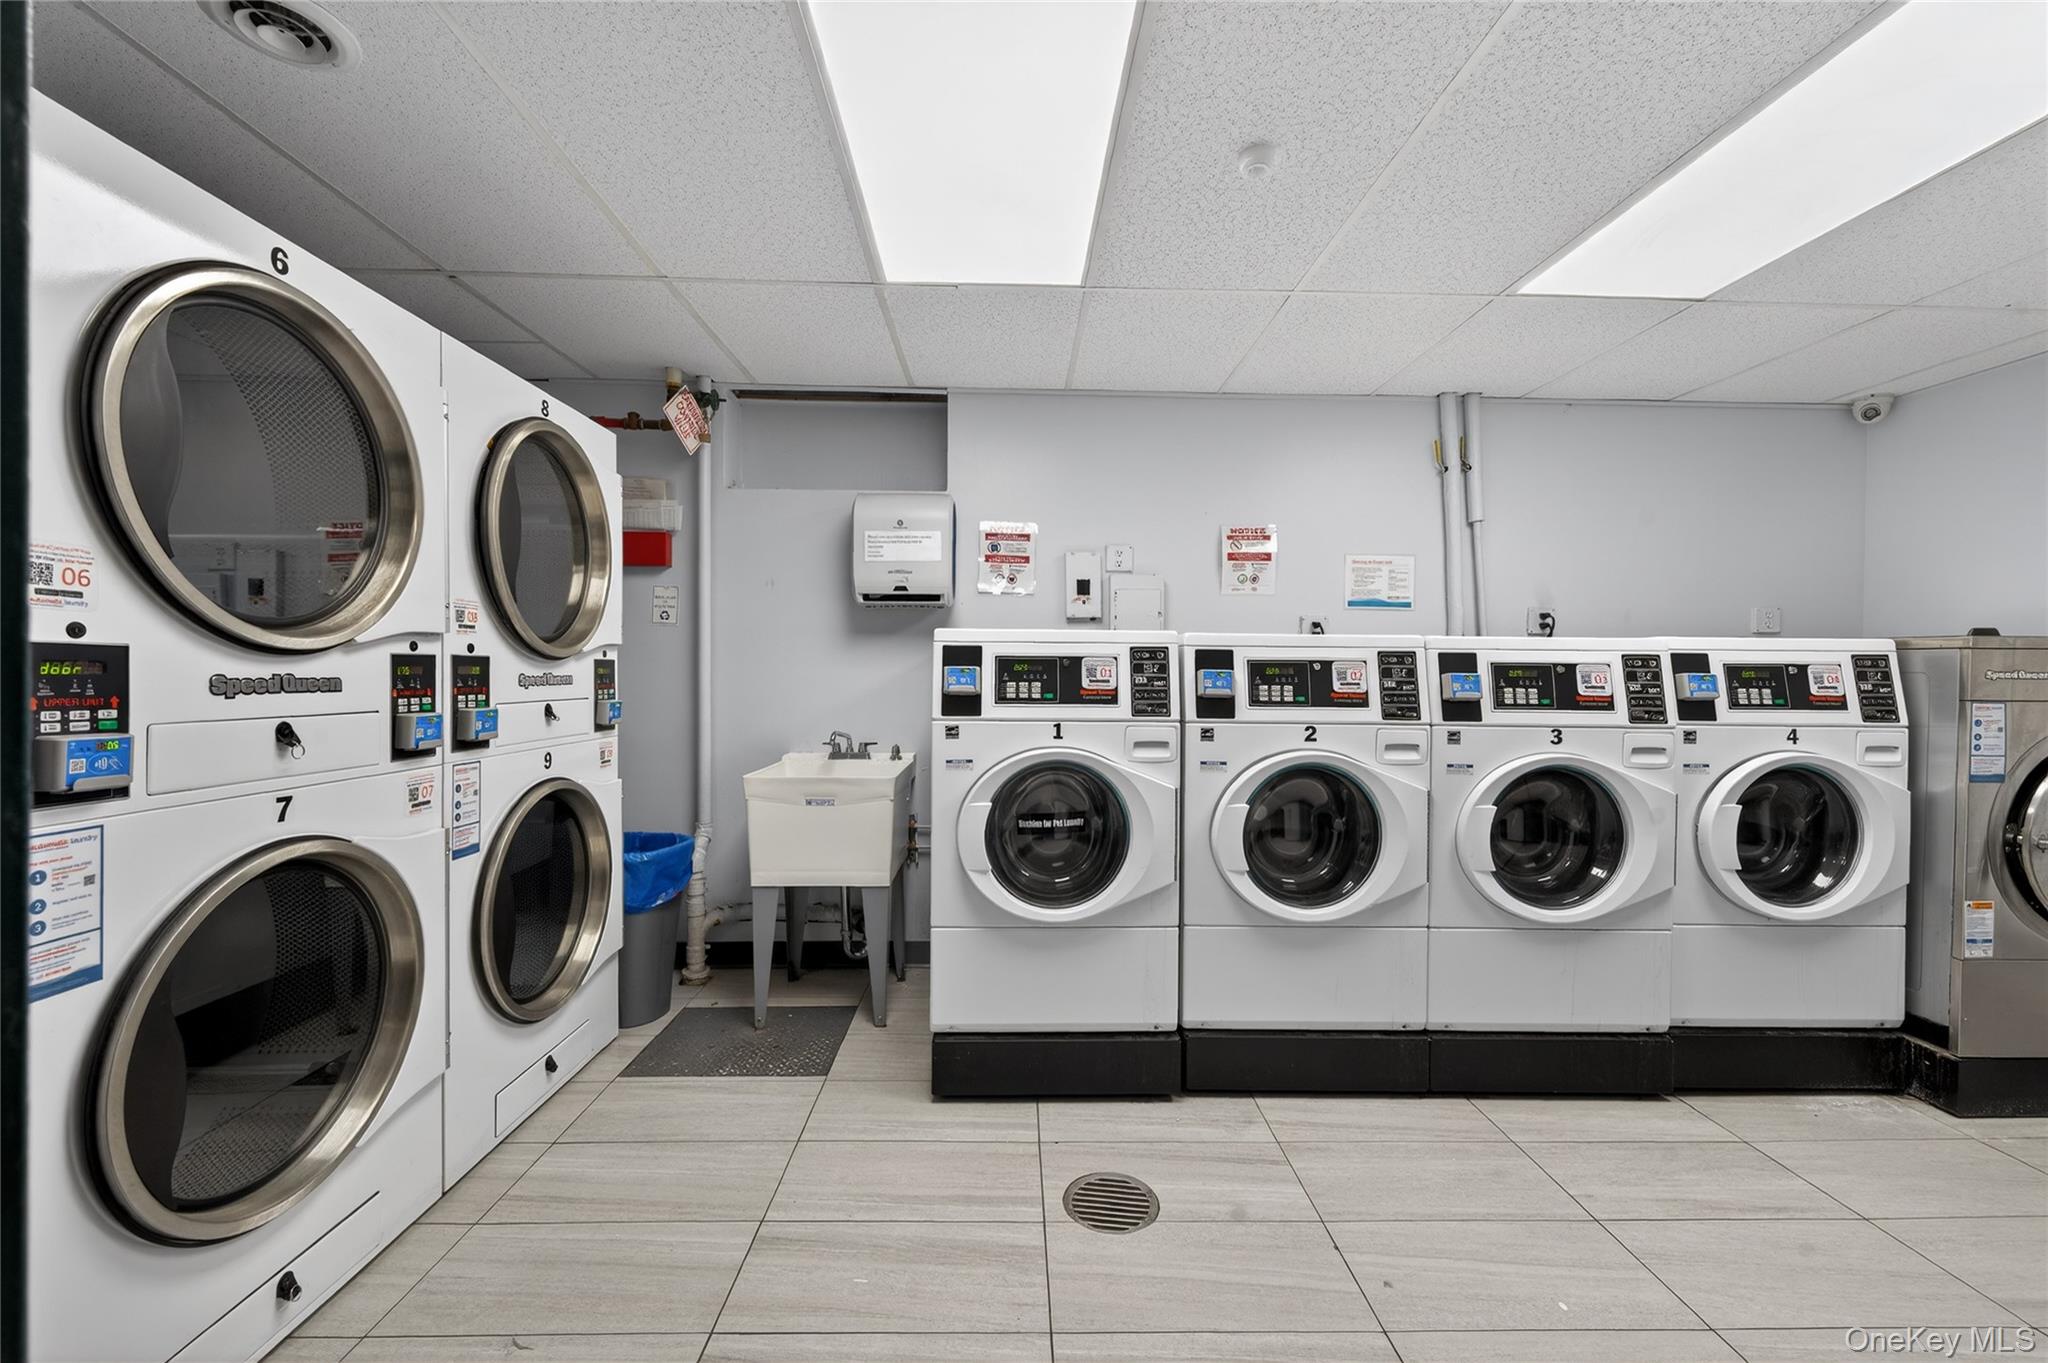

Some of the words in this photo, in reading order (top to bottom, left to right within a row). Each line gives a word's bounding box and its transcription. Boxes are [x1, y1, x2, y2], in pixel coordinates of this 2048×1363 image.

[270, 246, 290, 275] 6
[540, 400, 550, 418] 8
[62, 566, 91, 587] 06
[39, 663, 82, 676] door
[1100, 667, 1112, 678] 01
[1350, 670, 1363, 681] 02
[1985, 669, 2018, 681] Speed
[209, 673, 282, 700] Speed
[281, 672, 343, 694] Queen
[518, 672, 547, 690] Speed
[1594, 674, 1608, 684] 03
[43, 697, 80, 708] UPPER
[82, 696, 105, 707] UNIT
[1052, 723, 1064, 740] 1
[1304, 725, 1318, 742] 2
[1550, 728, 1563, 745] 3
[1786, 728, 1800, 745] 4
[543, 751, 552, 770] 9
[421, 785, 434, 798] 07
[275, 795, 294, 823] 7
